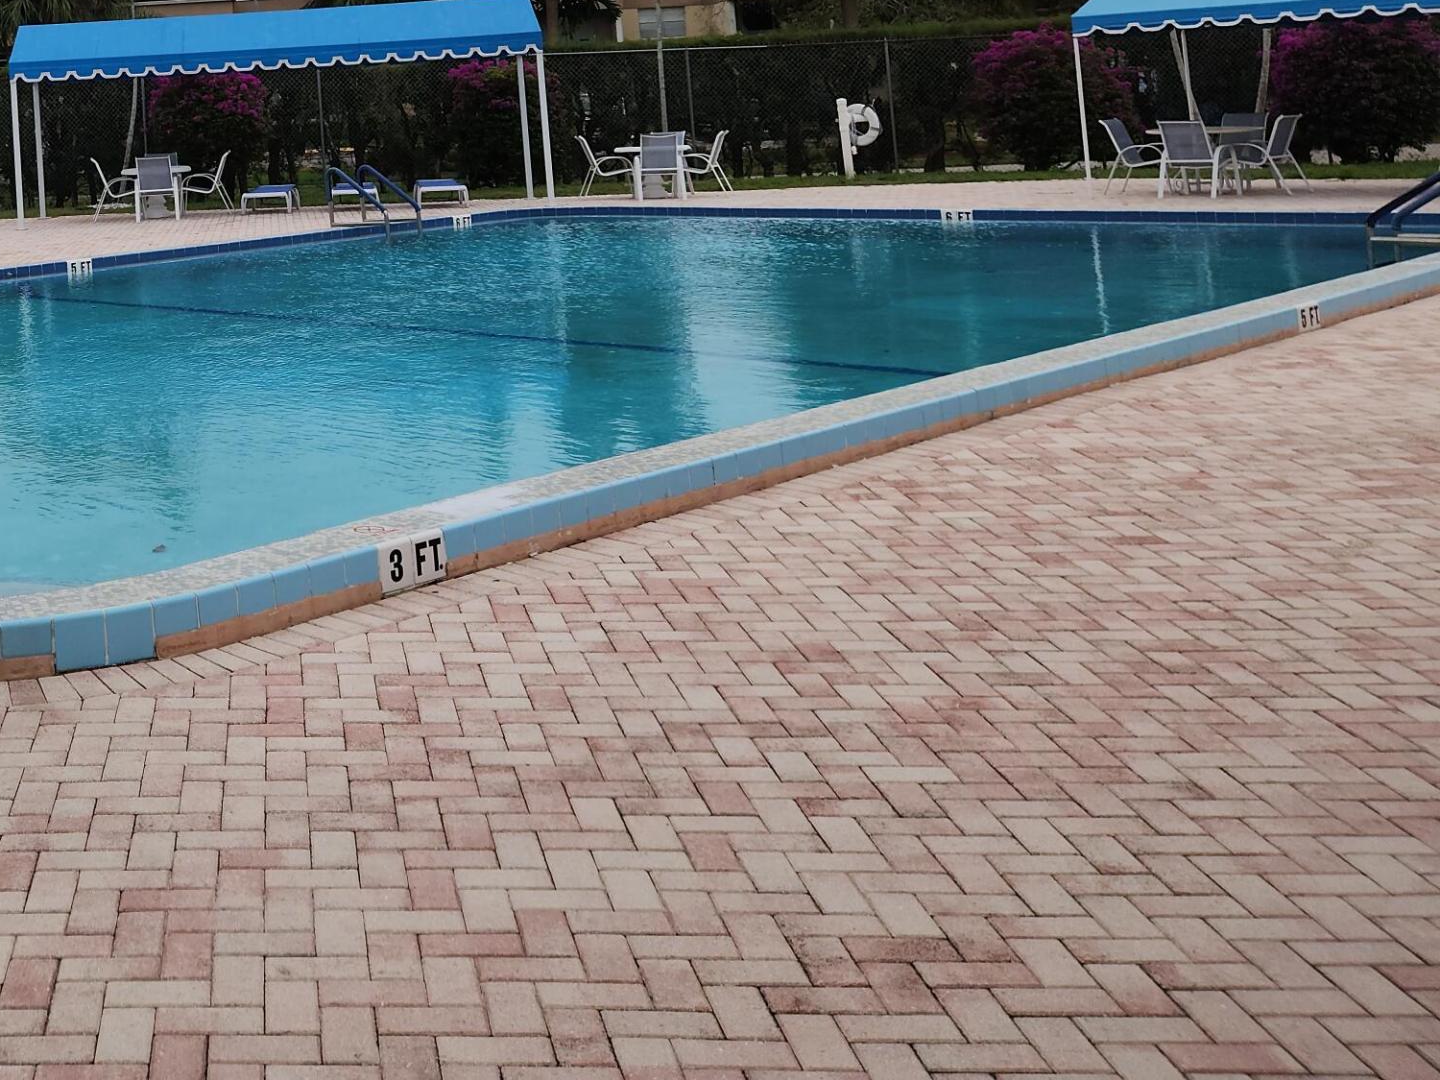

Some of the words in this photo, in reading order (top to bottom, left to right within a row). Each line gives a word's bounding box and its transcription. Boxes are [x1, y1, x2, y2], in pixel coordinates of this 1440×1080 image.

[957, 211, 971, 222] FT
[80, 260, 91, 273] FT
[1300, 308, 1307, 329] 5
[389, 548, 404, 583] 3
[414, 536, 444, 577] FT.
